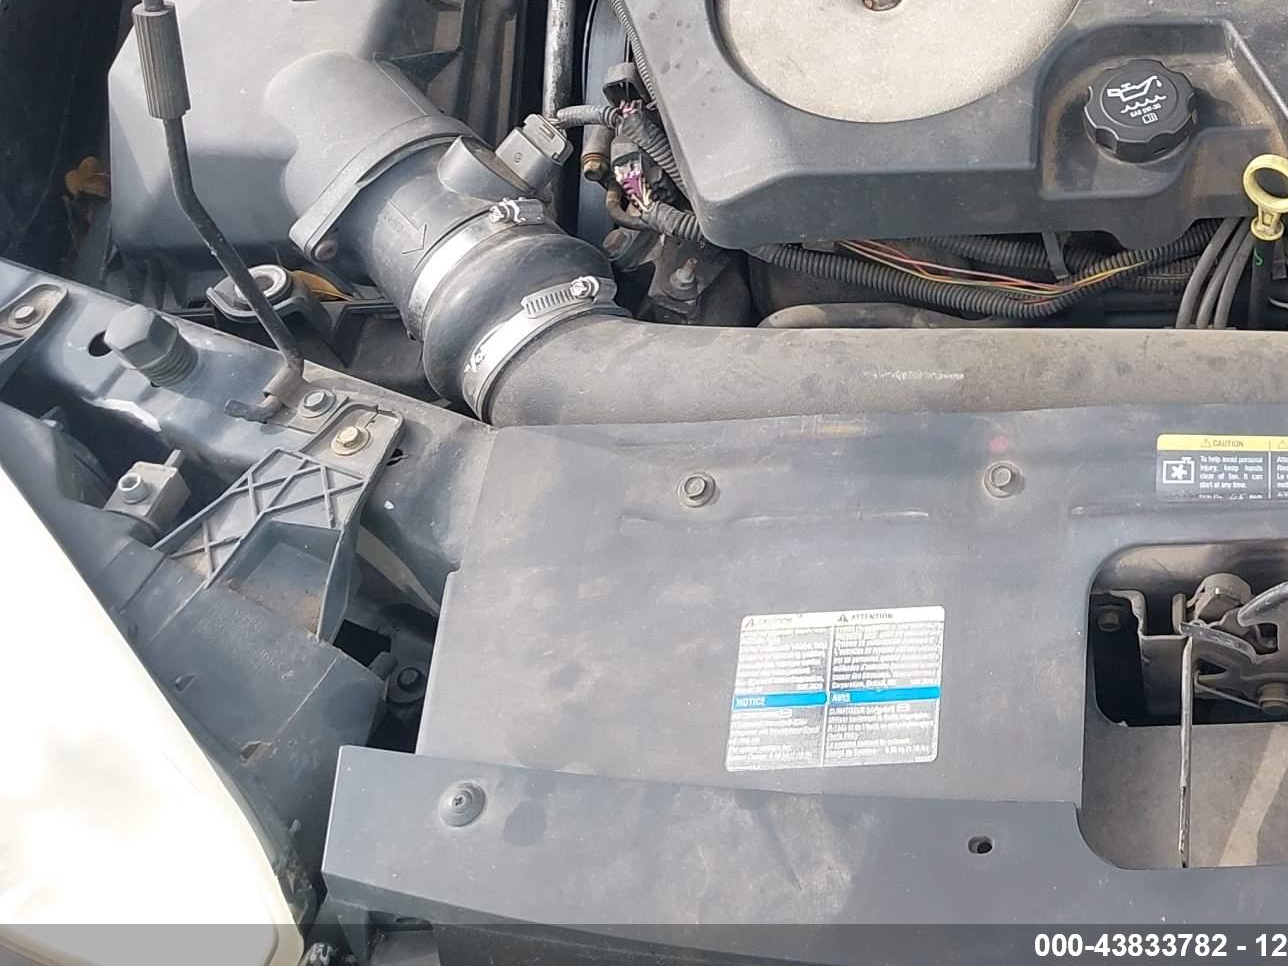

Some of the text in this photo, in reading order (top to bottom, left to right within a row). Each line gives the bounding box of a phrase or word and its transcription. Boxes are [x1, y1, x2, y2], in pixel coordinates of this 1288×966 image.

[1212, 439, 1244, 448] CAUTION
[1208, 455, 1221, 464] help
[1223, 464, 1239, 473] keep
[850, 612, 893, 621] ATTENTION
[735, 696, 767, 707] NOTICE
[831, 693, 850, 702] AVIS
